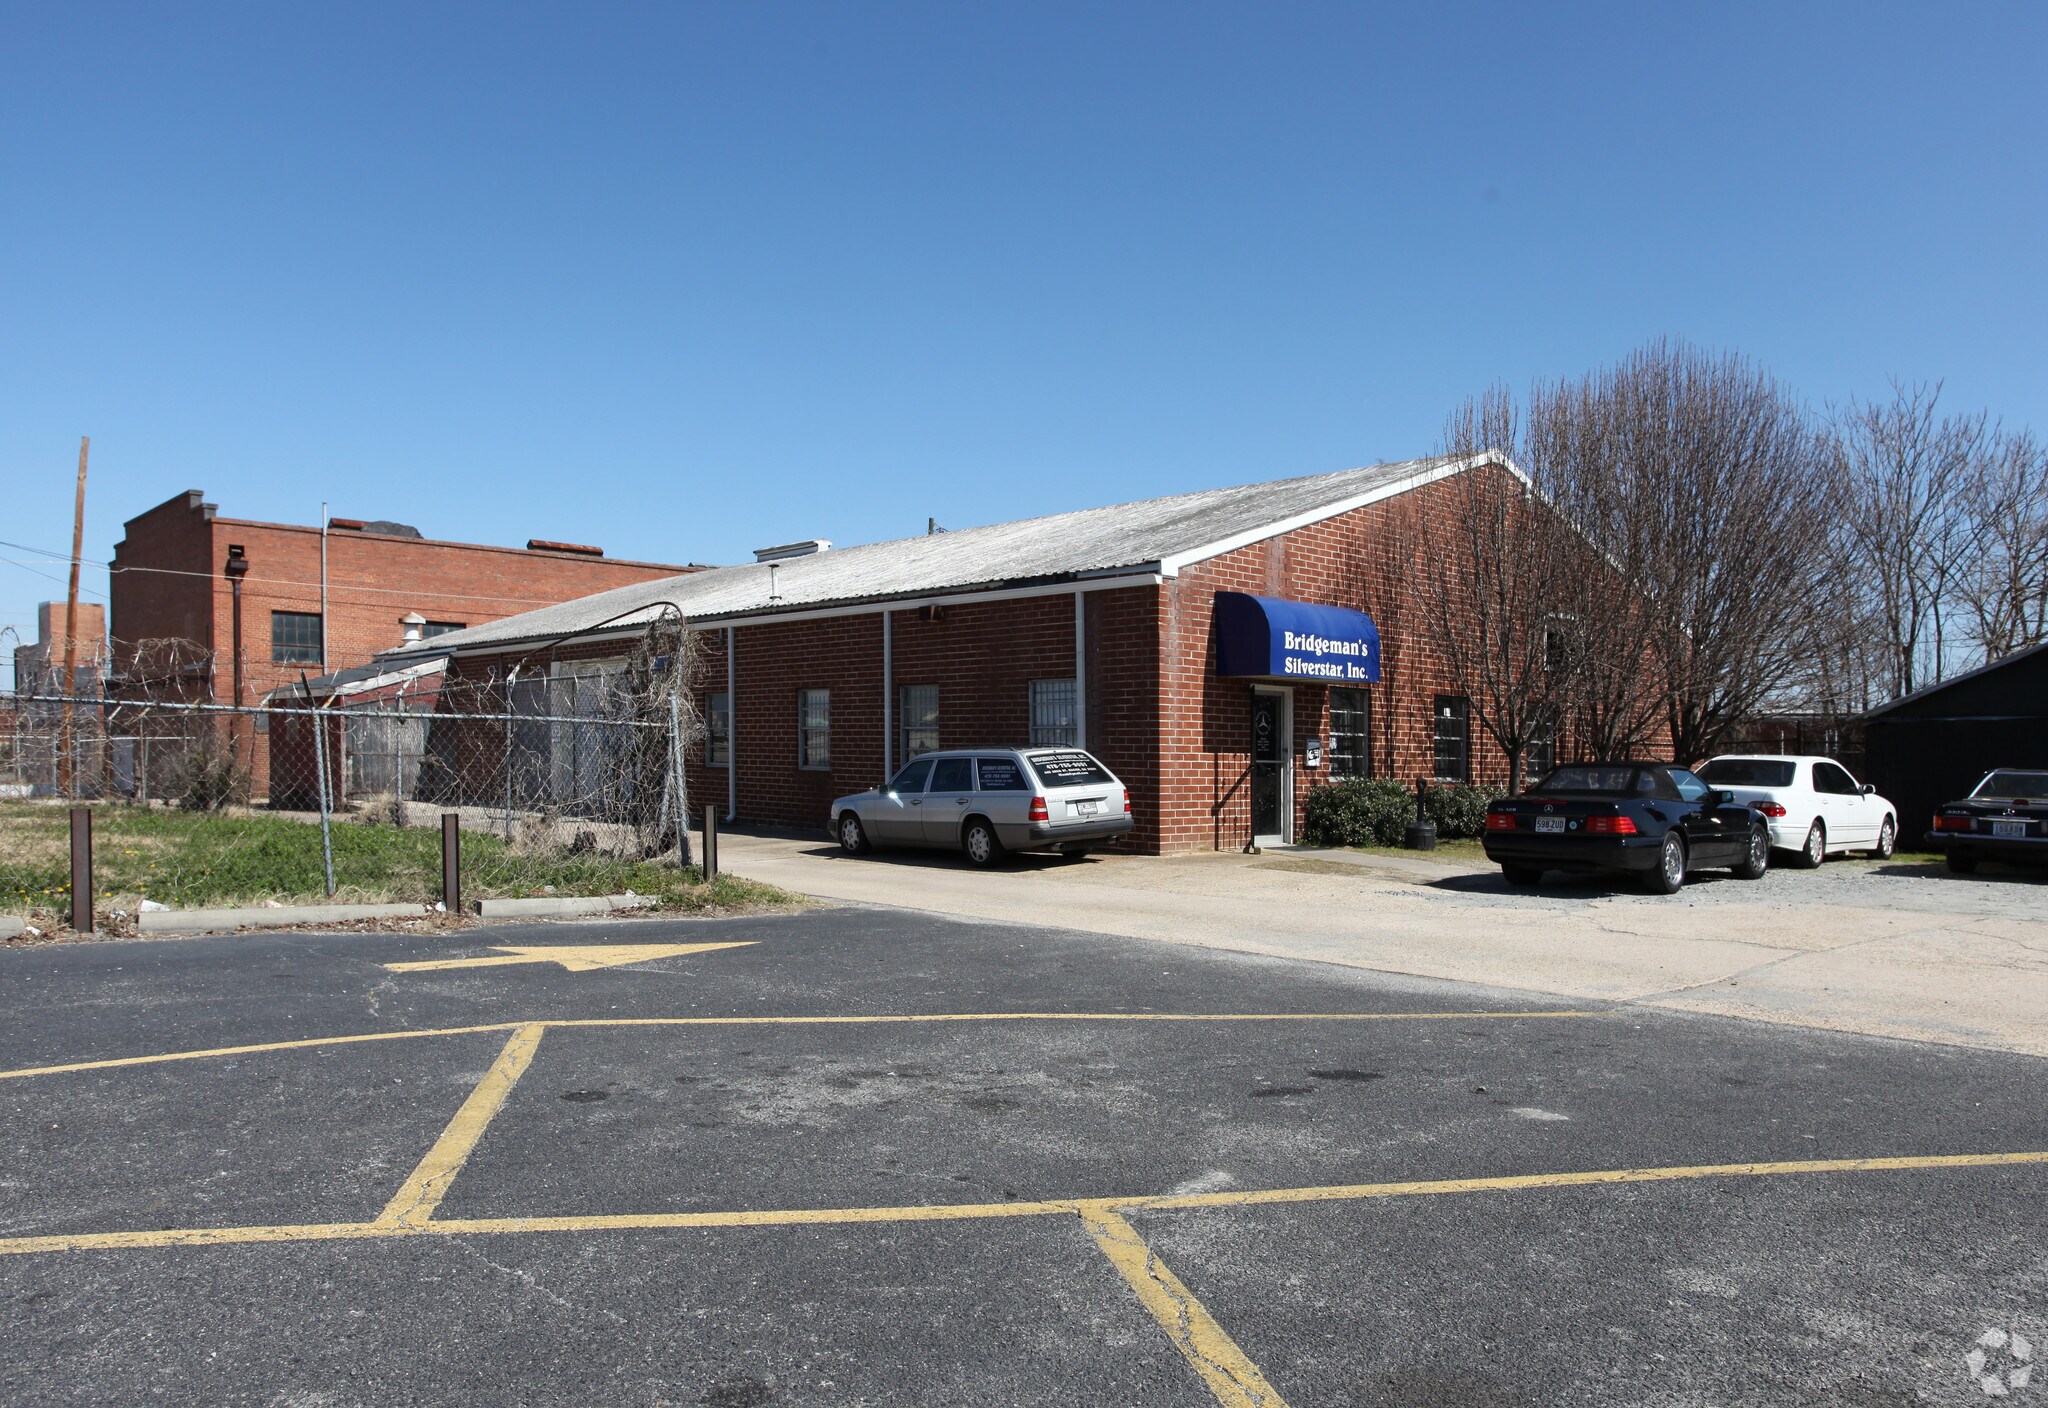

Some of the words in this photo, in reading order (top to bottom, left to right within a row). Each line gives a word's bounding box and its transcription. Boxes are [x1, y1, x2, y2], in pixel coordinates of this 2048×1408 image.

[1284, 631, 1368, 657] Bridgeman's
[1284, 656, 1345, 678] Silverstar,
[1347, 662, 1369, 679] Inc.
[1536, 820, 1550, 828] 598
[1550, 820, 1564, 828] ZUD
